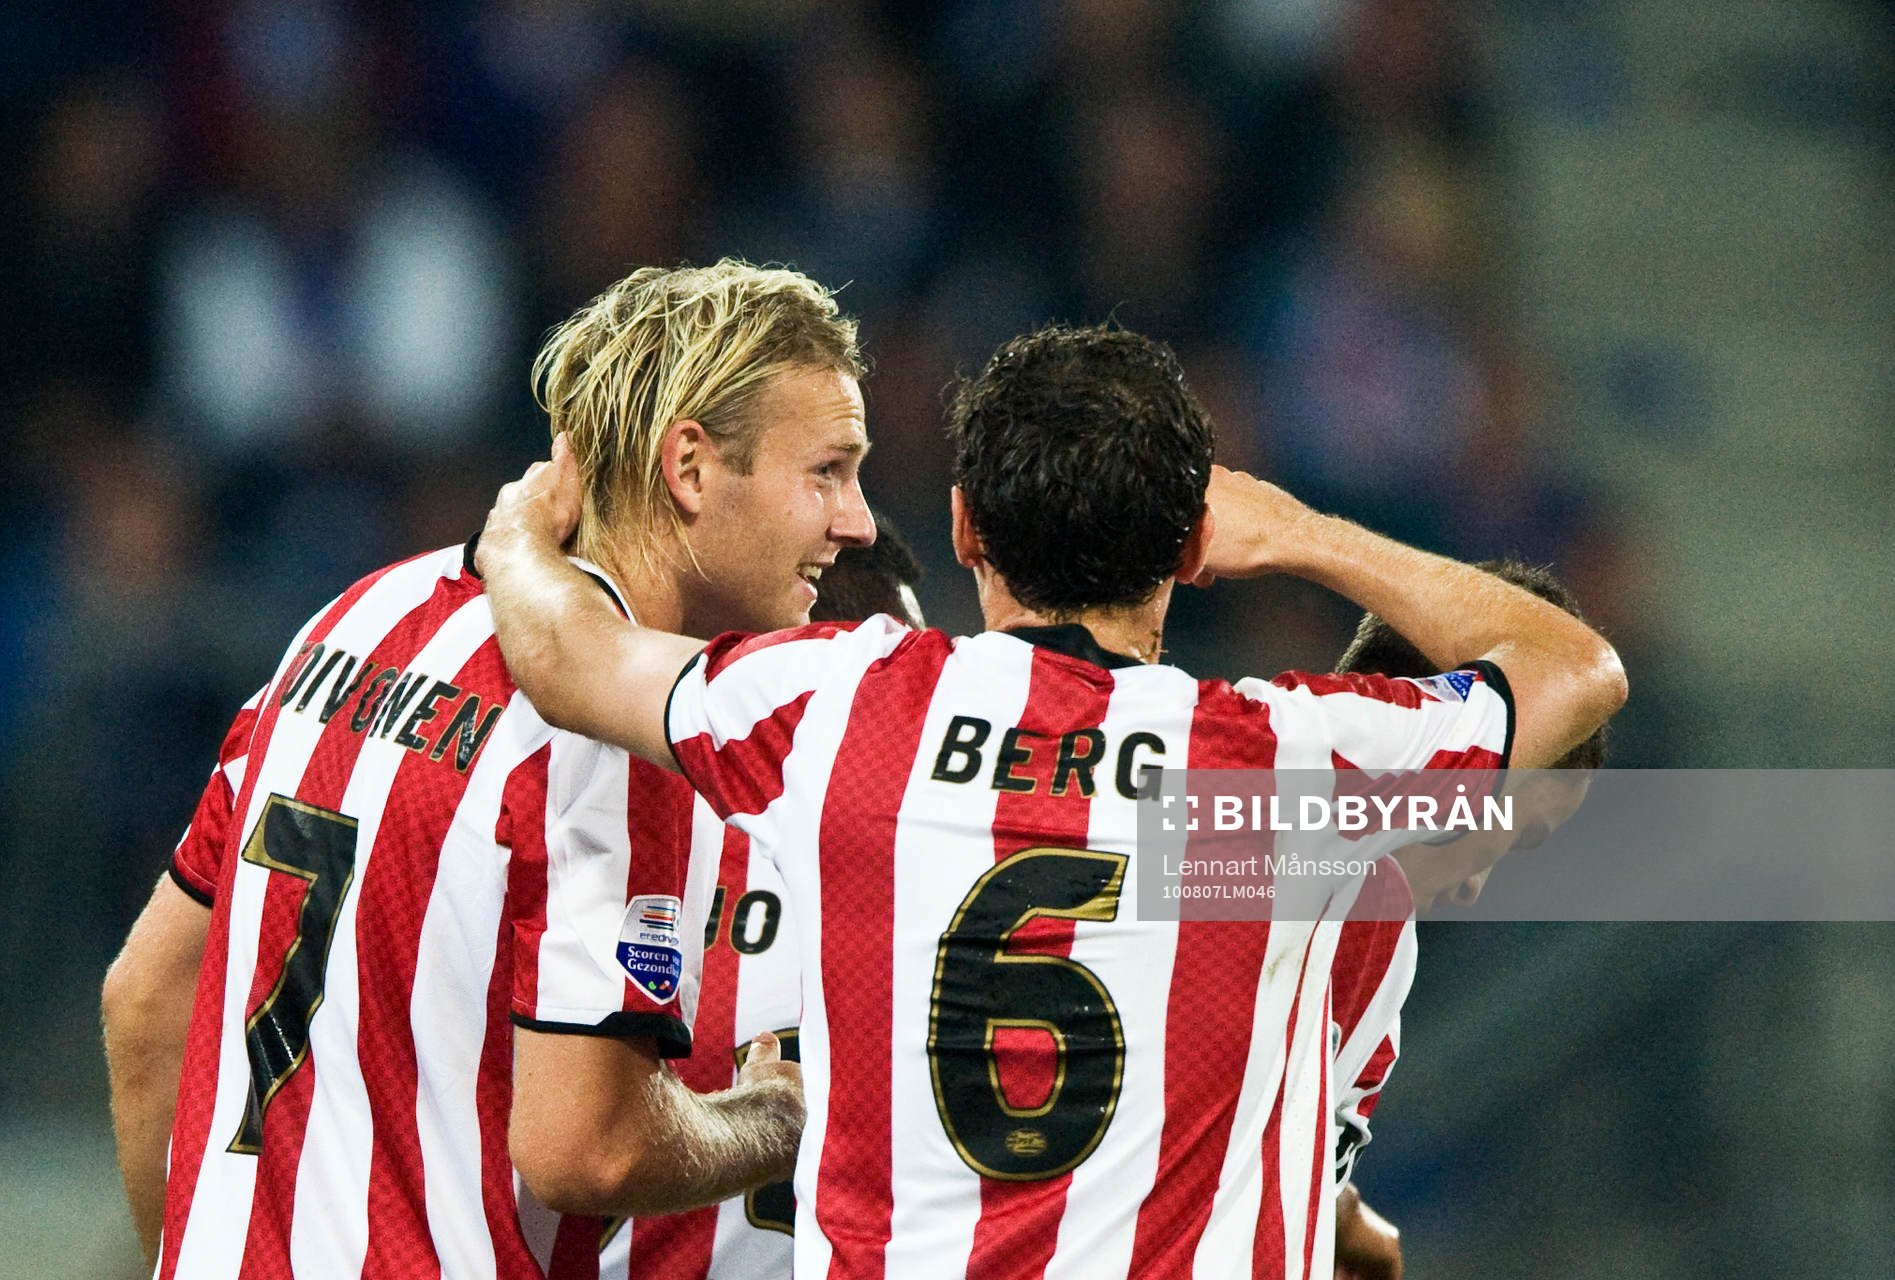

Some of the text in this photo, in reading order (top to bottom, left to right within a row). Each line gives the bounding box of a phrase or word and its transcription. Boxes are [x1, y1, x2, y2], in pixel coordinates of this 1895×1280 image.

[268, 641, 504, 774] OIVONEN
[931, 714, 1167, 802] BERG
[225, 792, 359, 1155] 7
[627, 945, 669, 962] Scoren
[927, 846, 1130, 1182] 6
